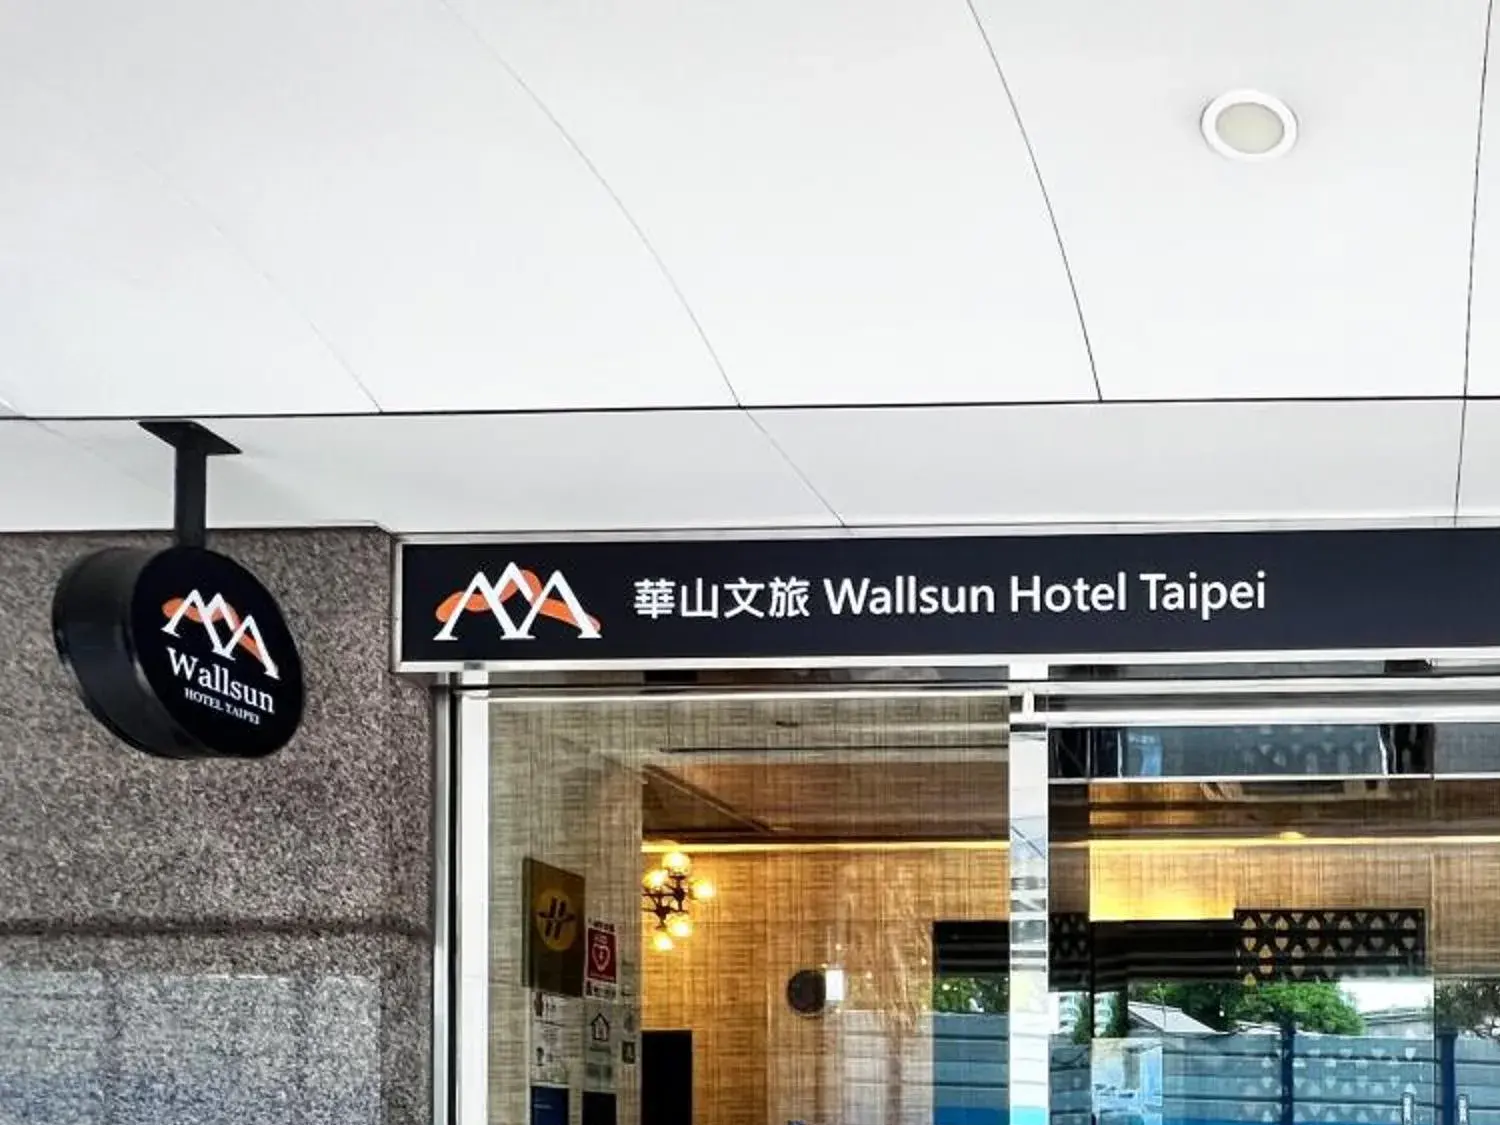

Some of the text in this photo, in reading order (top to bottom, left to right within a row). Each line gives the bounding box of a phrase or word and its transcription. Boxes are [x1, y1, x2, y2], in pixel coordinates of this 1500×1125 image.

[632, 570, 1266, 621] 華山文旅 Wallsun Hotel Taipei
[166, 646, 275, 714] Wallsun
[183, 687, 261, 726] HOTEL TAIPEI
